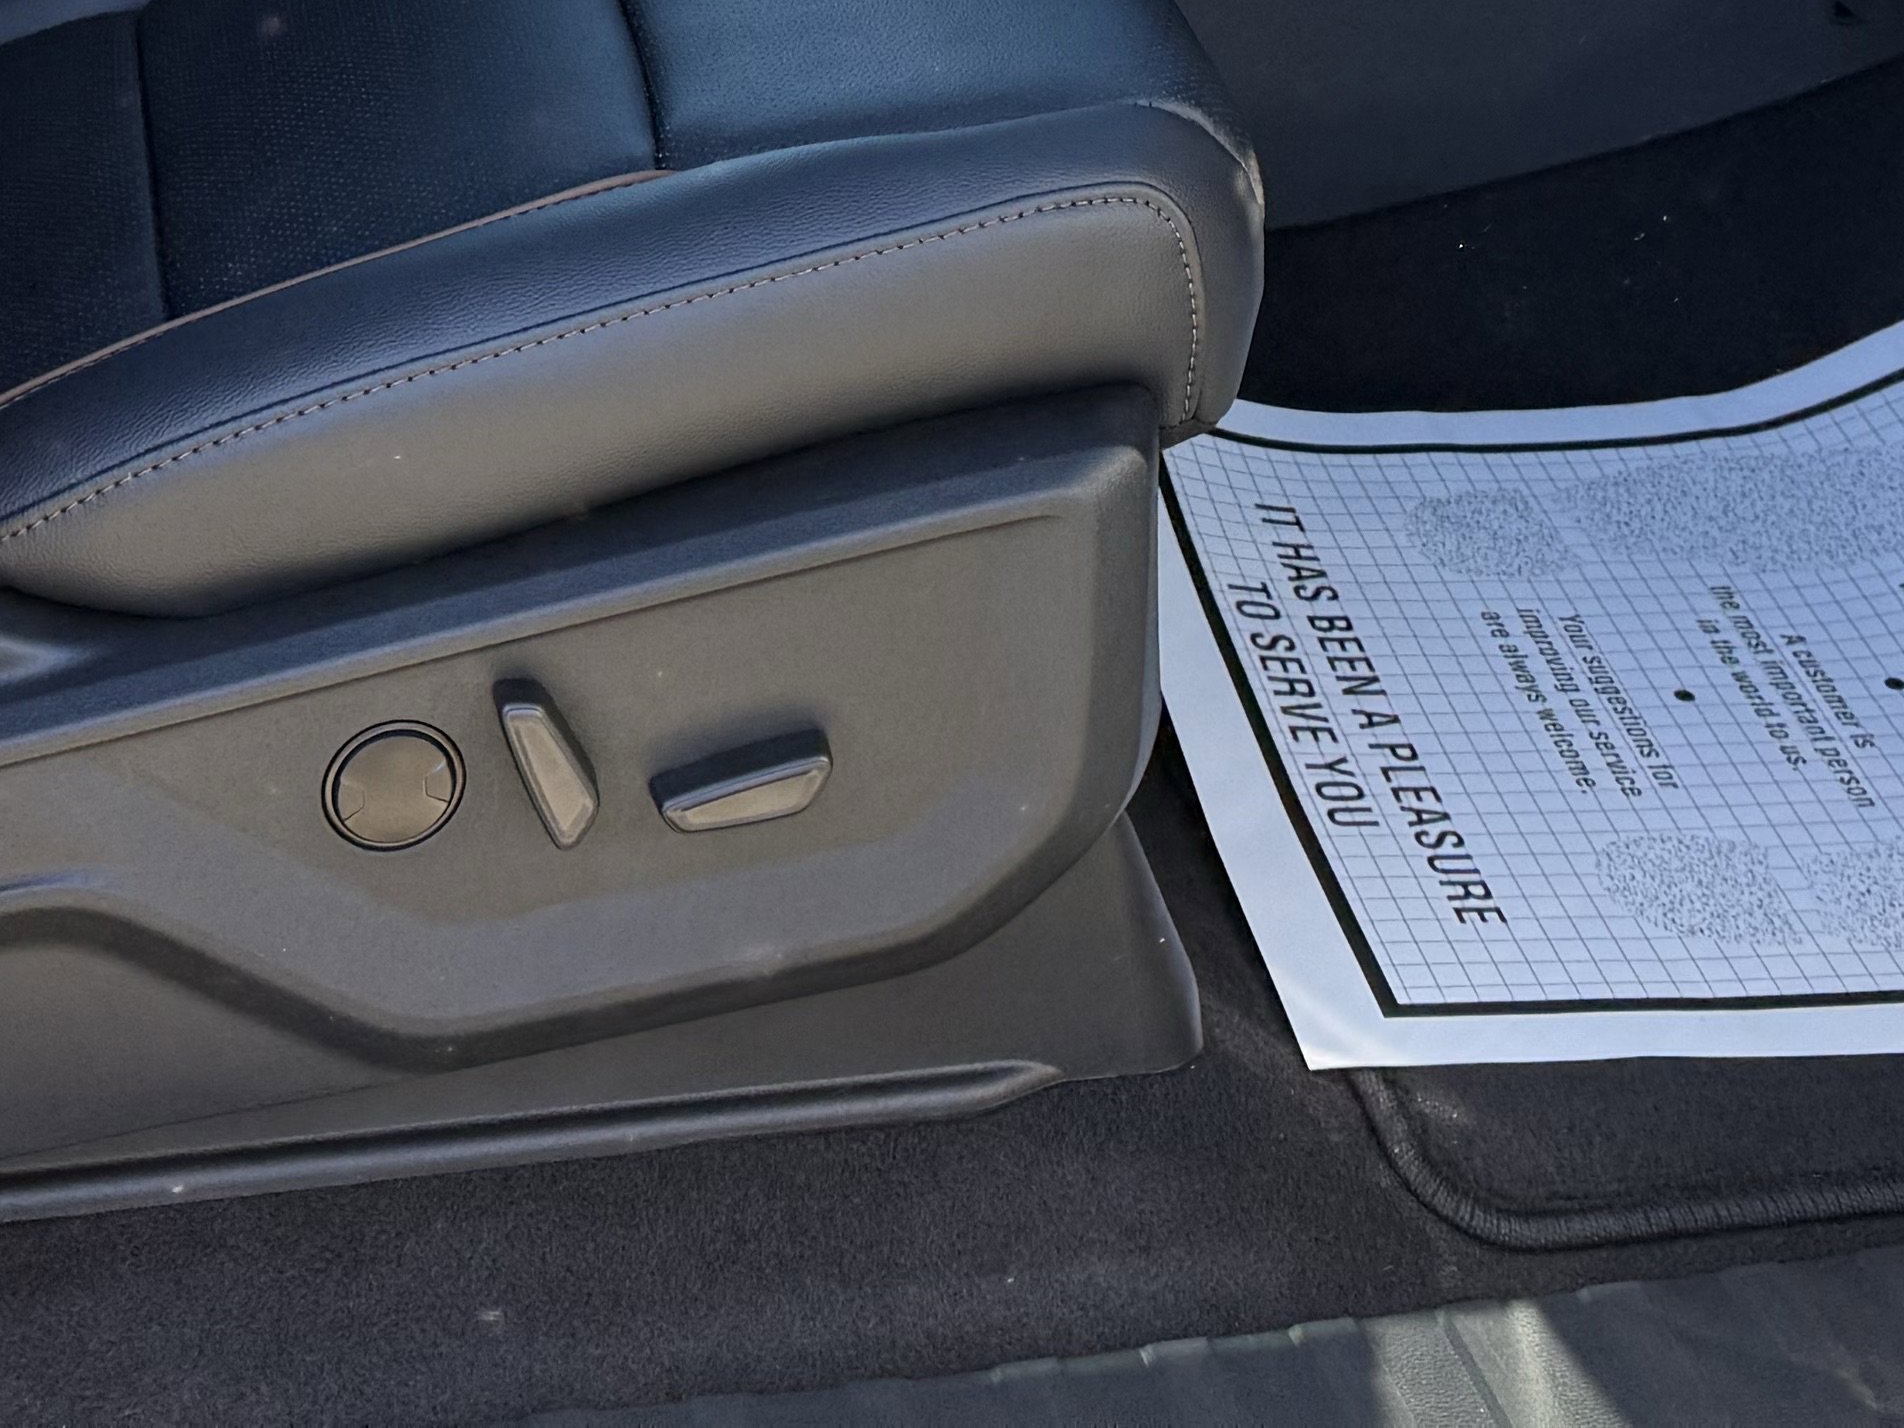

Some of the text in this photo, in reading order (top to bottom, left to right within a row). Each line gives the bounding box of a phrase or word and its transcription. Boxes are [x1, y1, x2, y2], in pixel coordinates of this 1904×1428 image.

[1226, 581, 1381, 828] TO SERVE YOU
[1254, 503, 1509, 925] IT HAS BEEN A PLEASURE
[1481, 610, 1597, 795] are always welcome.
[1517, 608, 1642, 798] improving our service
[1559, 613, 1679, 790] Your suggestions for
[1697, 618, 1807, 771] in the world to us.
[1710, 585, 1875, 808] the most important person
[1780, 633, 1875, 749] A customer is
